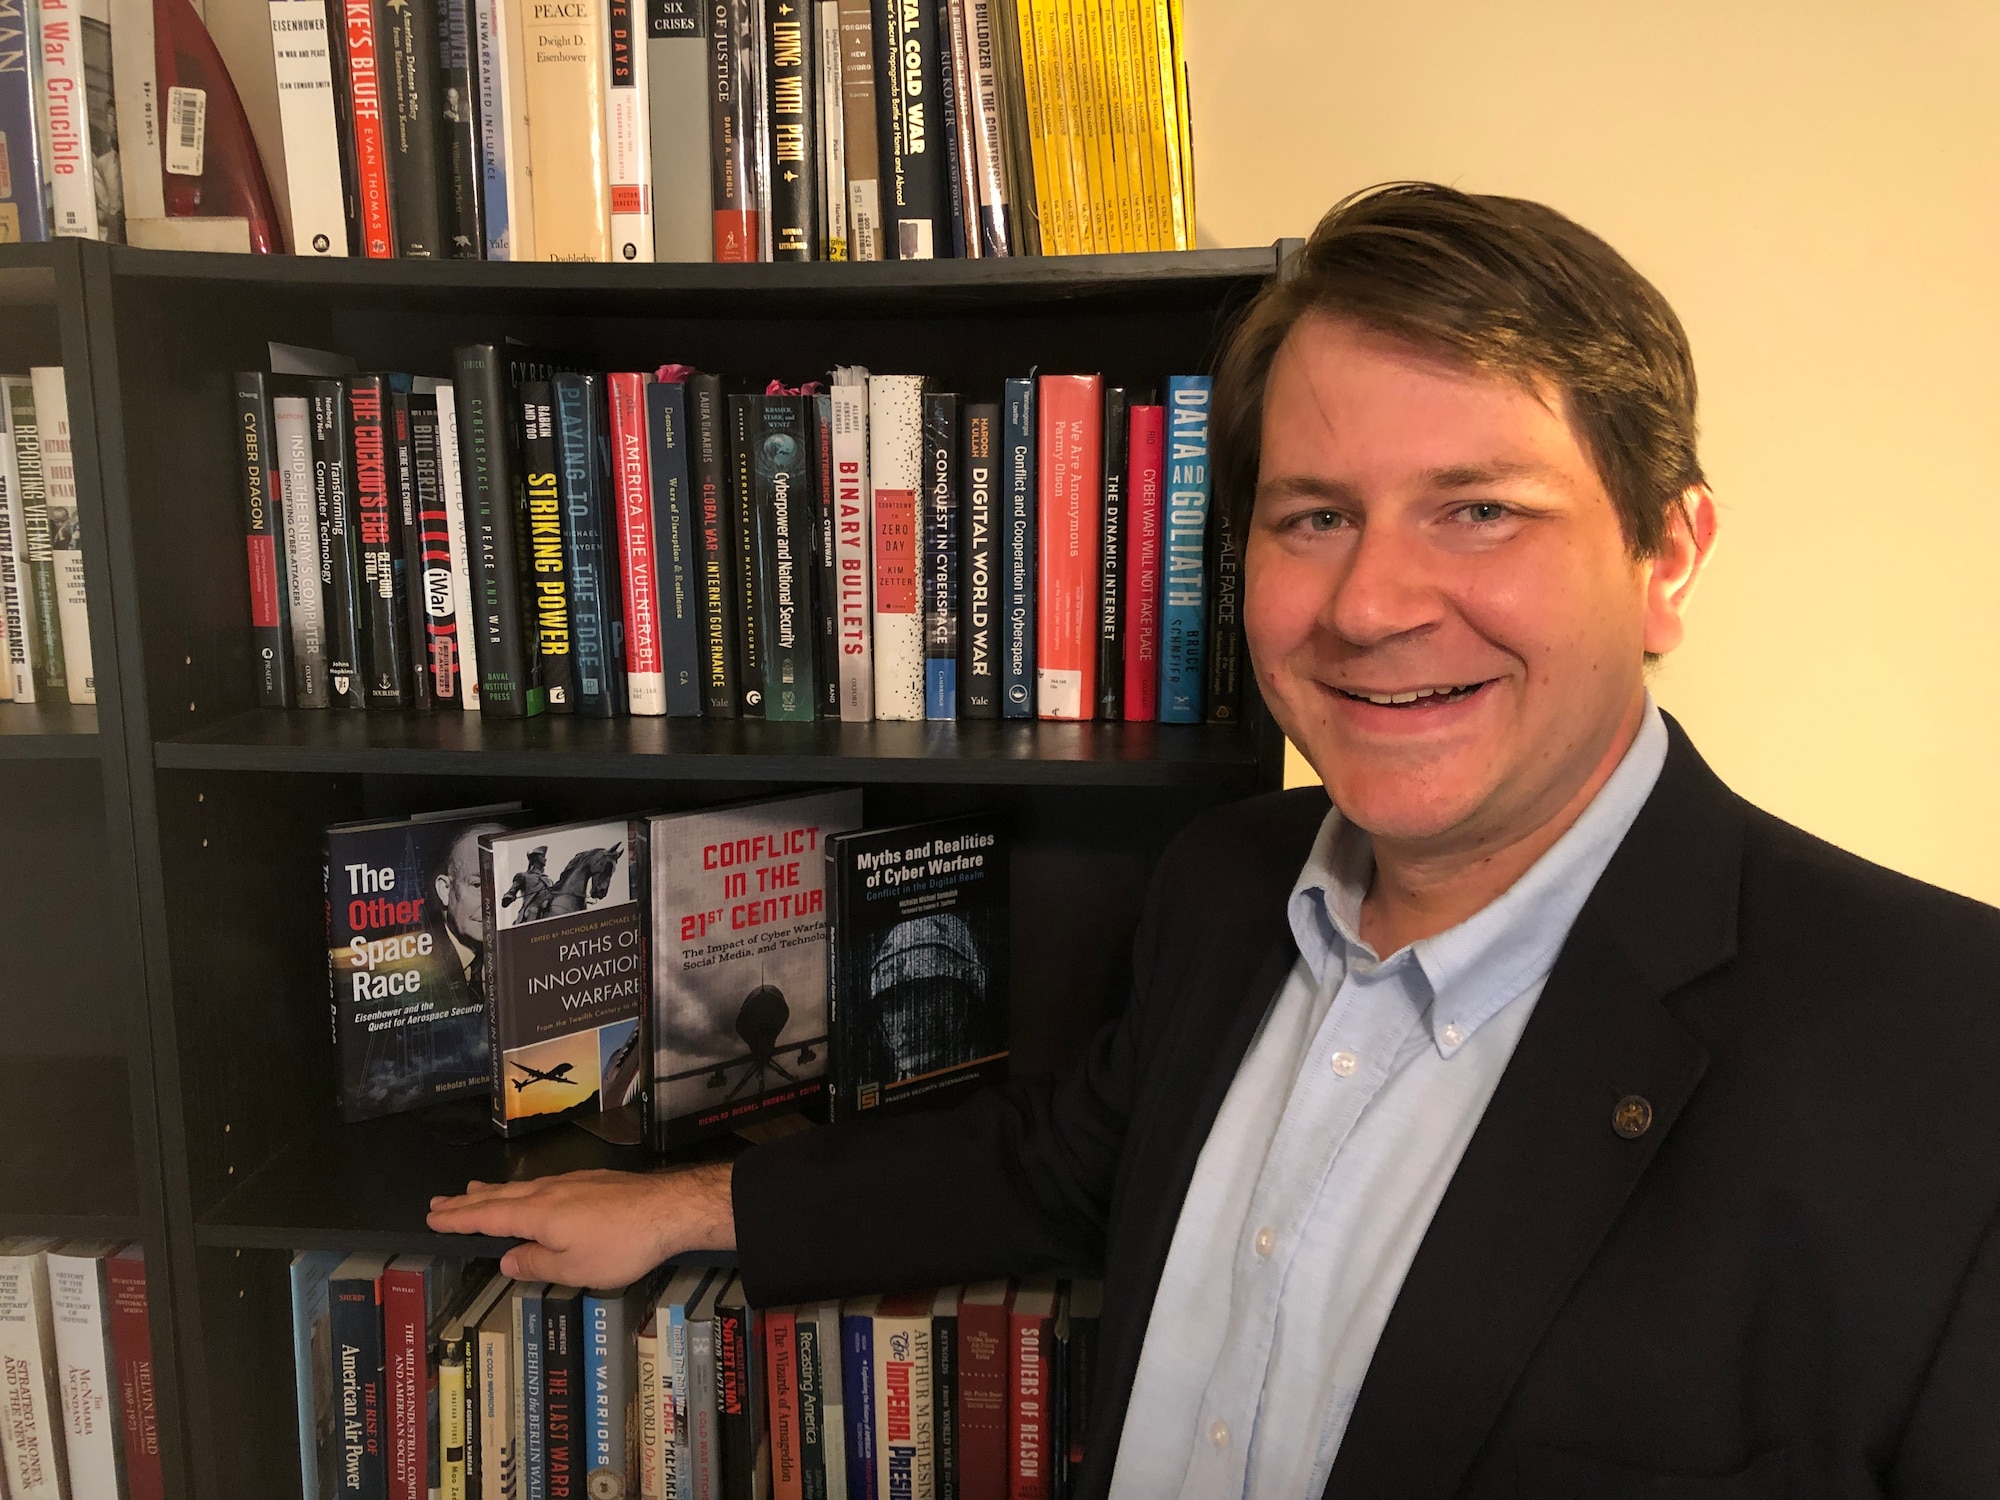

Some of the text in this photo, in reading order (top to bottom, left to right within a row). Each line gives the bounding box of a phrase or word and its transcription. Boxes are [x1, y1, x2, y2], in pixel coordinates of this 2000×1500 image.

[273, 19, 325, 31] EISENHOWER
[534, 4, 587, 18] PEACE
[655, 19, 695, 30] CRISES
[663, 4, 683, 13] SIX
[480, 12, 494, 107] UNWARRANTED
[536, 52, 587, 63] Eisenhower
[539, 35, 586, 47] Dwight D.
[614, 29, 629, 76] DAYS
[716, 4, 730, 102] OF JUSTICE
[975, 3, 995, 112] BULLDOZER IN THE
[403, 10, 418, 120] American Defense Policy
[847, 63, 871, 71] SWORD
[44, 22, 79, 174] War Crucible
[347, 0, 382, 230] KE'S BLUFF EVAN THOMAS
[773, 21, 804, 165] LIVING WITH PERIL
[905, 39, 925, 155] COLD WAR
[485, 114, 498, 180] INFLUENCE
[489, 239, 510, 249] Yale
[464, 360, 485, 369] LIBICKI
[244, 412, 260, 461] CYBER
[663, 406, 676, 450] Demchak
[1012, 401, 1020, 426] Lowther
[1023, 390, 1031, 437] Yannakogeorgos
[971, 418, 980, 458] KULLAH
[980, 418, 989, 458] HAROON
[1053, 421, 1066, 498] Parmy Olson
[14, 425, 46, 500] REPORTING
[350, 385, 390, 544] THE CUCKOO'S EGG
[247, 466, 264, 530] DRAGON
[331, 461, 344, 535] Transforming
[1168, 389, 1209, 607] DATA AND GOLIATH
[24, 505, 53, 561] VIETNAM
[315, 461, 332, 585] Computer Technology
[882, 523, 908, 535] ZERO
[885, 540, 905, 551] DAY
[528, 473, 570, 656] STRIKING POWER
[839, 462, 864, 656] BINARY BULLETS
[933, 449, 948, 645] CONQUEST IN CYBERSPACE
[1104, 475, 1120, 641] THE DYNAMIC INTERNET
[377, 552, 393, 598] CLIFFORD
[429, 572, 449, 613] iWar
[703, 483, 725, 688] GLOBAL WAR INTERNET GOVERNANCE
[879, 577, 913, 586] ZETTER
[972, 468, 989, 676] DIGITAL WORLD WAR
[1, 555, 25, 664] AND ALLEGIANCE
[1185, 630, 1200, 673] BRUCE
[703, 826, 819, 871] CONFLICT
[857, 833, 994, 871] Myths and Realities
[866, 855, 984, 888] of Cyber Warfare
[345, 863, 395, 895] The
[725, 862, 800, 899] IN THE
[348, 896, 425, 931] Other
[681, 889, 823, 941] 21ST CENTUR
[349, 932, 433, 971] Space
[559, 935, 612, 962] PATHS
[352, 970, 421, 1002] Race
[367, 1003, 484, 1032] Quest for Aerospace Security
[435, 1078, 467, 1093] Nicholas
[885, 1072, 980, 1103] PRAEGER SECURITY INTERNATIONAL
[391, 1285, 416, 1294] PAVELEC
[559, 1314, 567, 1355] KREPINEVICH
[548, 1369, 568, 1396] THE
[594, 1307, 610, 1466] CODE WARRIORS
[722, 1317, 742, 1415] SOVIET UNION
[800, 1332, 817, 1445] Recasting America
[138, 1361, 158, 1456] MELVIN LAIRD
[342, 1343, 364, 1490] American Air Power
[365, 1381, 378, 1457] THE RISE OF
[395, 1354, 405, 1483] AND AMERICAN SOCIETY
[549, 1403, 569, 1439] LAST
[774, 1325, 794, 1482] The Wizards of Armageddon
[1020, 1327, 1040, 1478] SOLDIERS OF REASON
